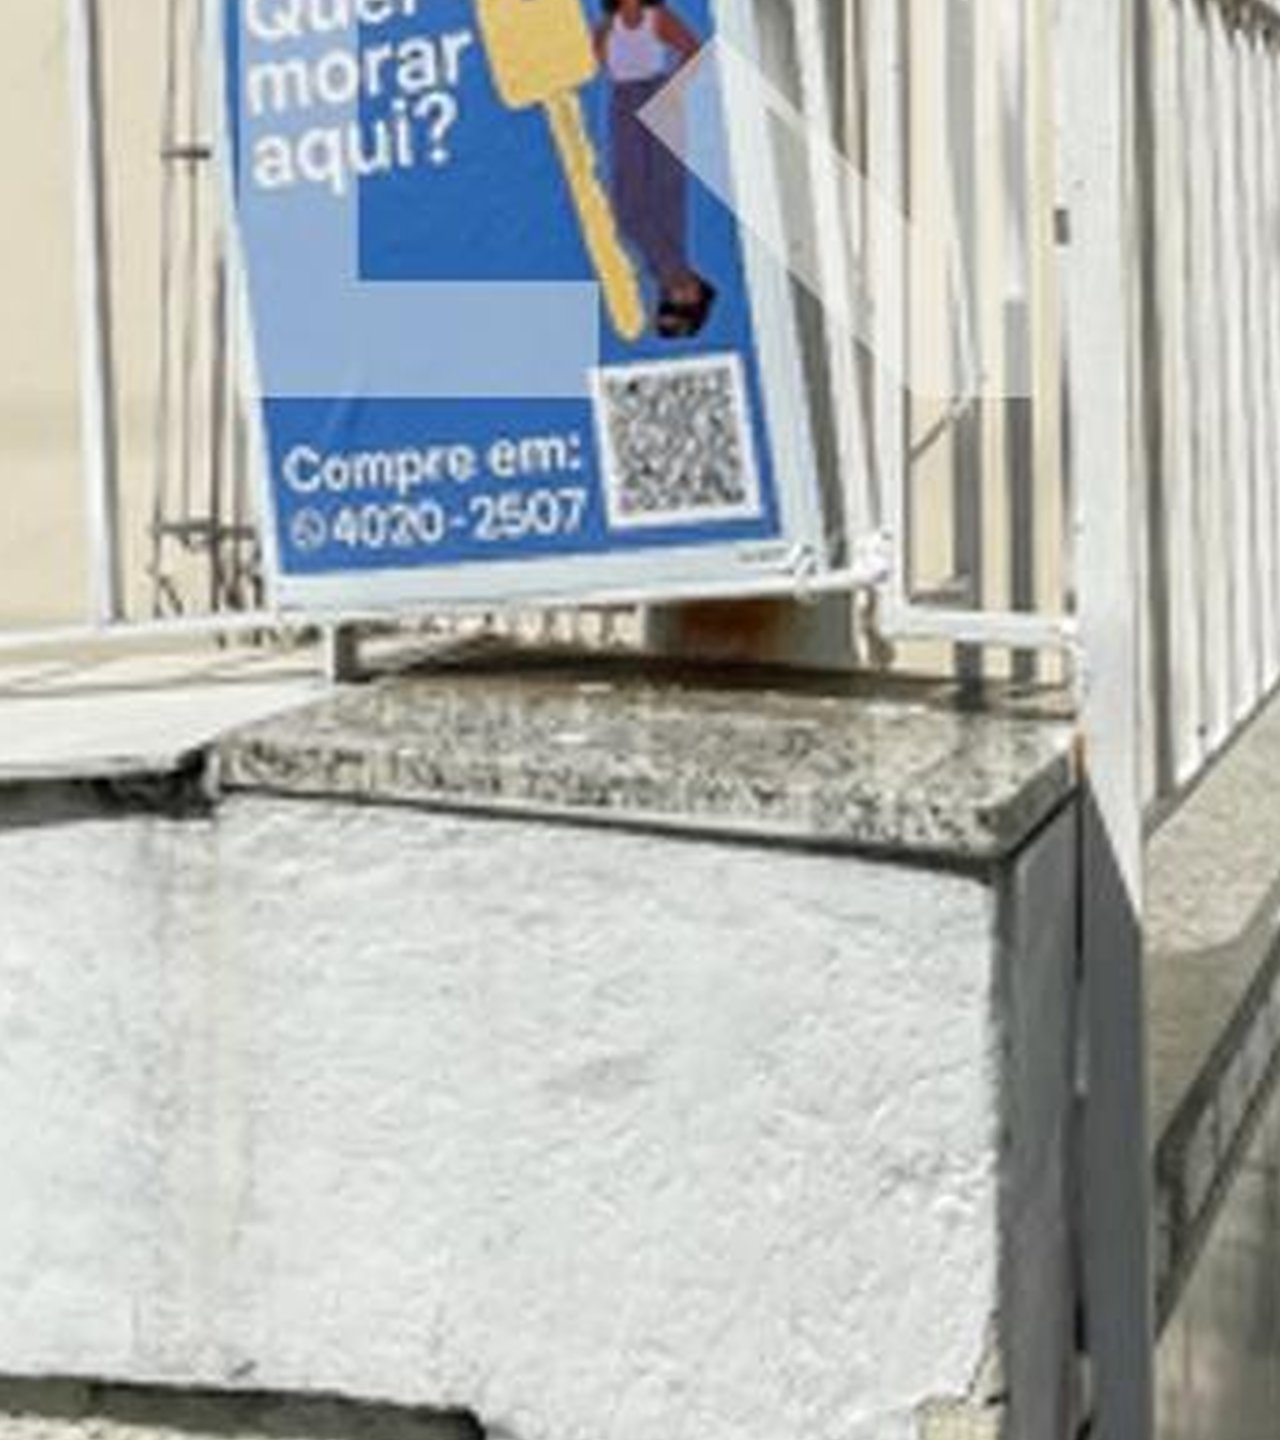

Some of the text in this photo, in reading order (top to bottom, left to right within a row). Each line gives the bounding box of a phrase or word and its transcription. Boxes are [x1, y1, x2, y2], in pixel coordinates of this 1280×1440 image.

[249, 29, 472, 115] morar
[253, 92, 458, 196] aqui?
[282, 432, 581, 495] Compre em:
[332, 486, 587, 549] 4020-2507
